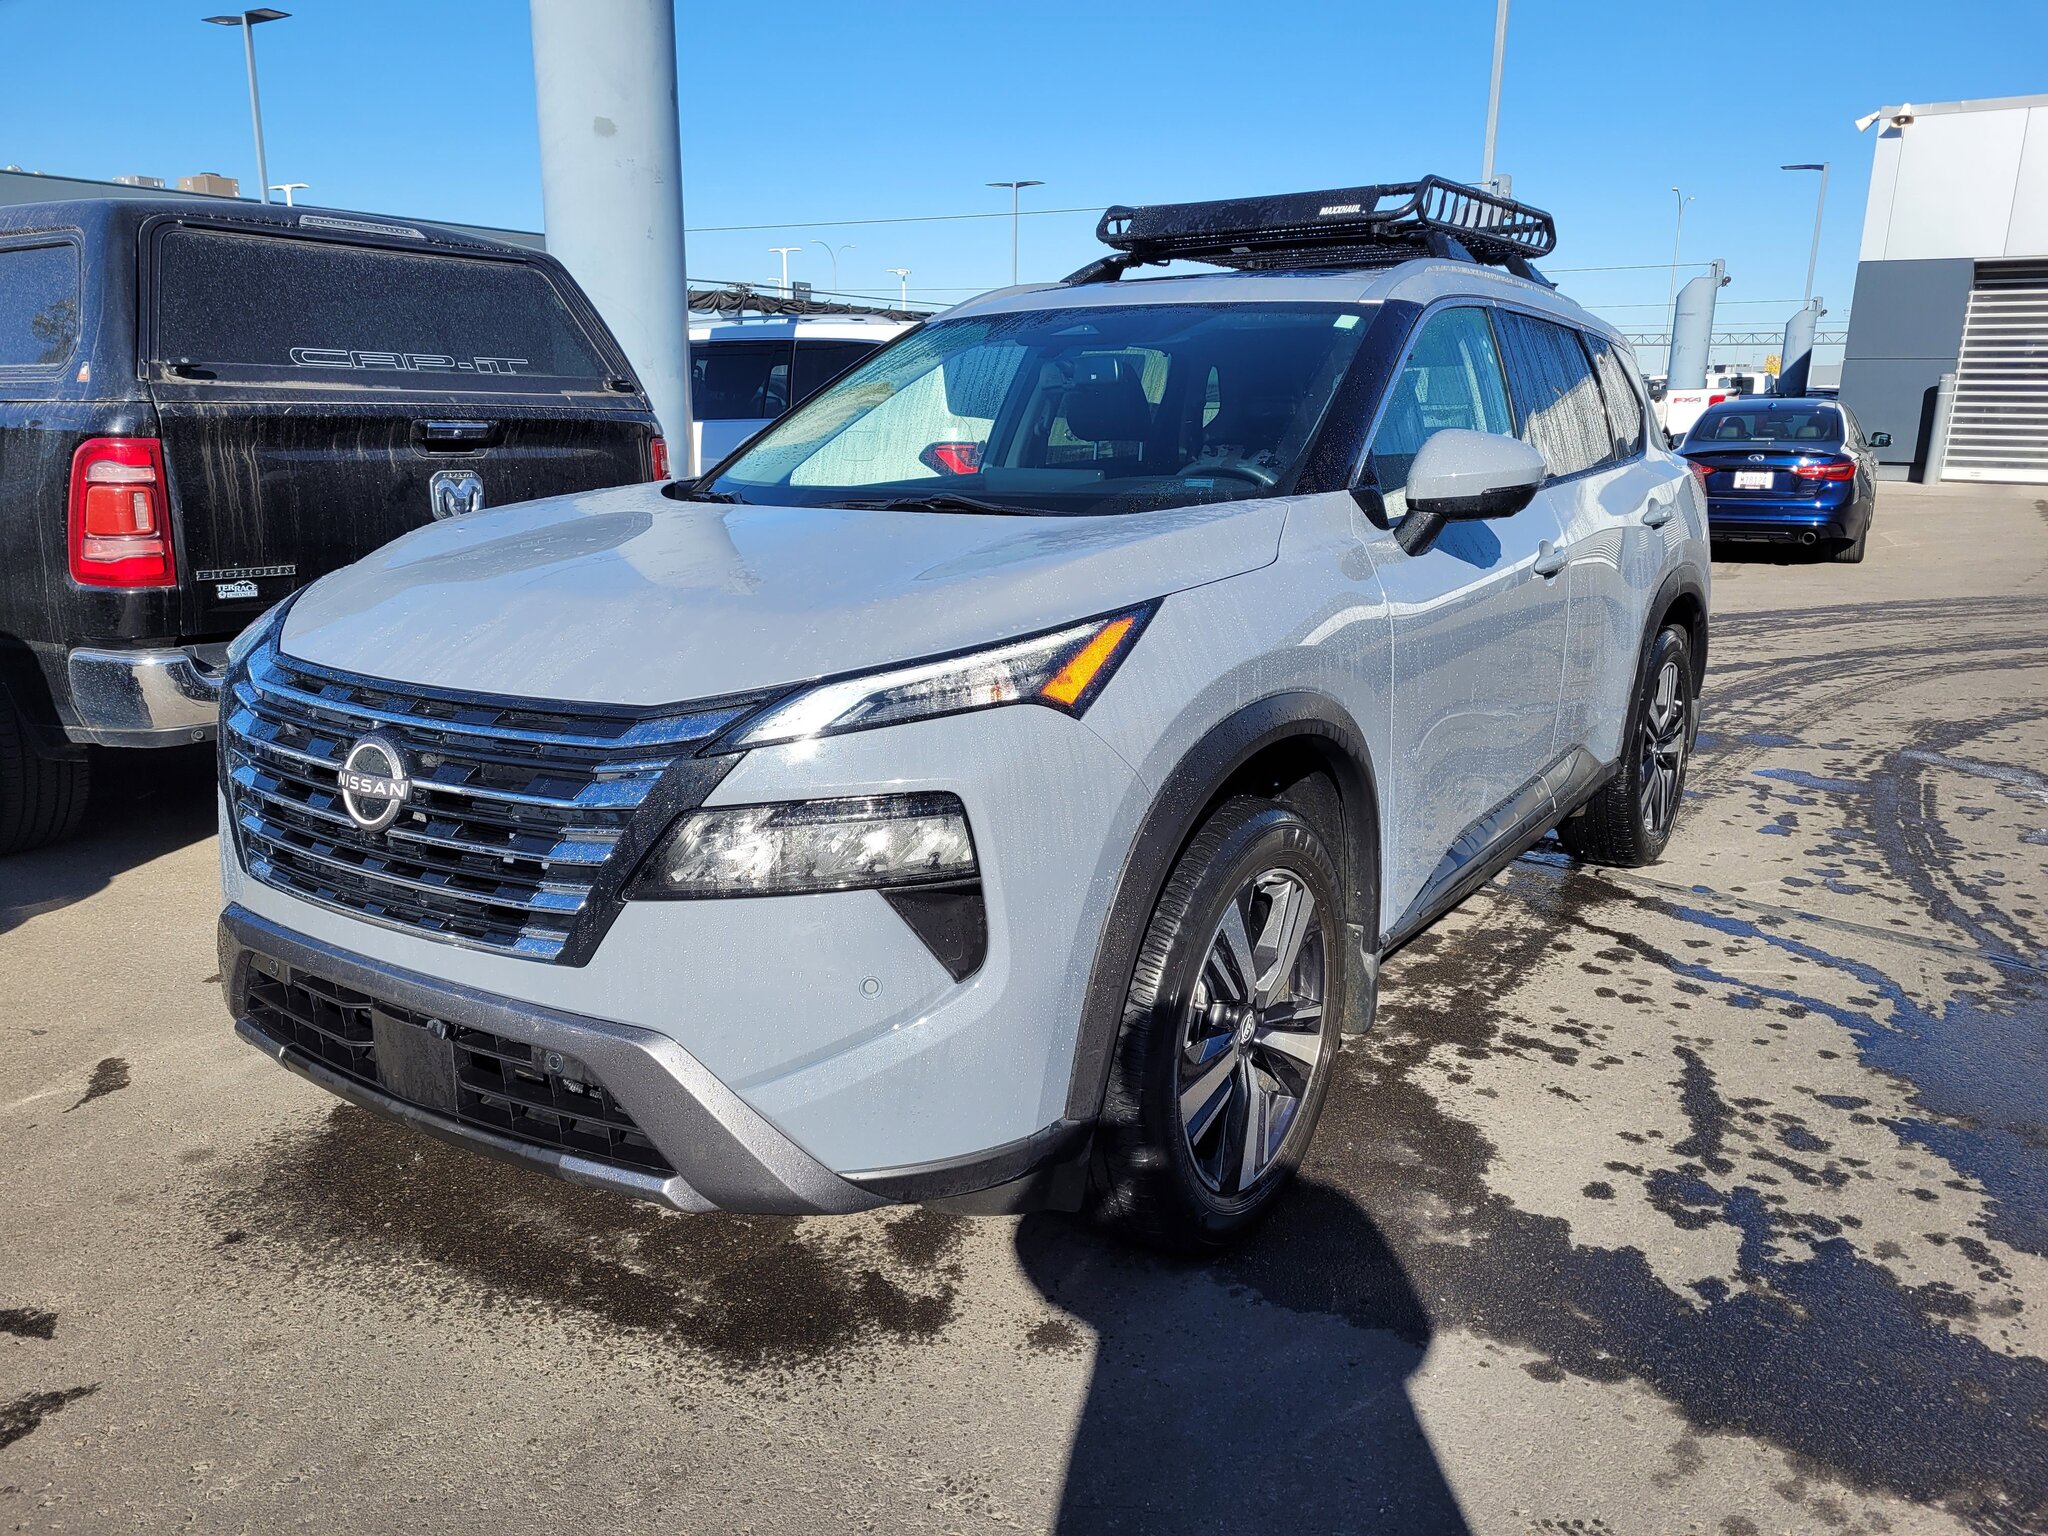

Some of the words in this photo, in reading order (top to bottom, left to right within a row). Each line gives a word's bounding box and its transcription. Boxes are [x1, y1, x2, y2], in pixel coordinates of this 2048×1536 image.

[1319, 204, 1361, 215] MAXXHAUL
[1673, 396, 1702, 404] FX4
[215, 583, 258, 592] TERRACE
[338, 770, 406, 798] NISSAN
